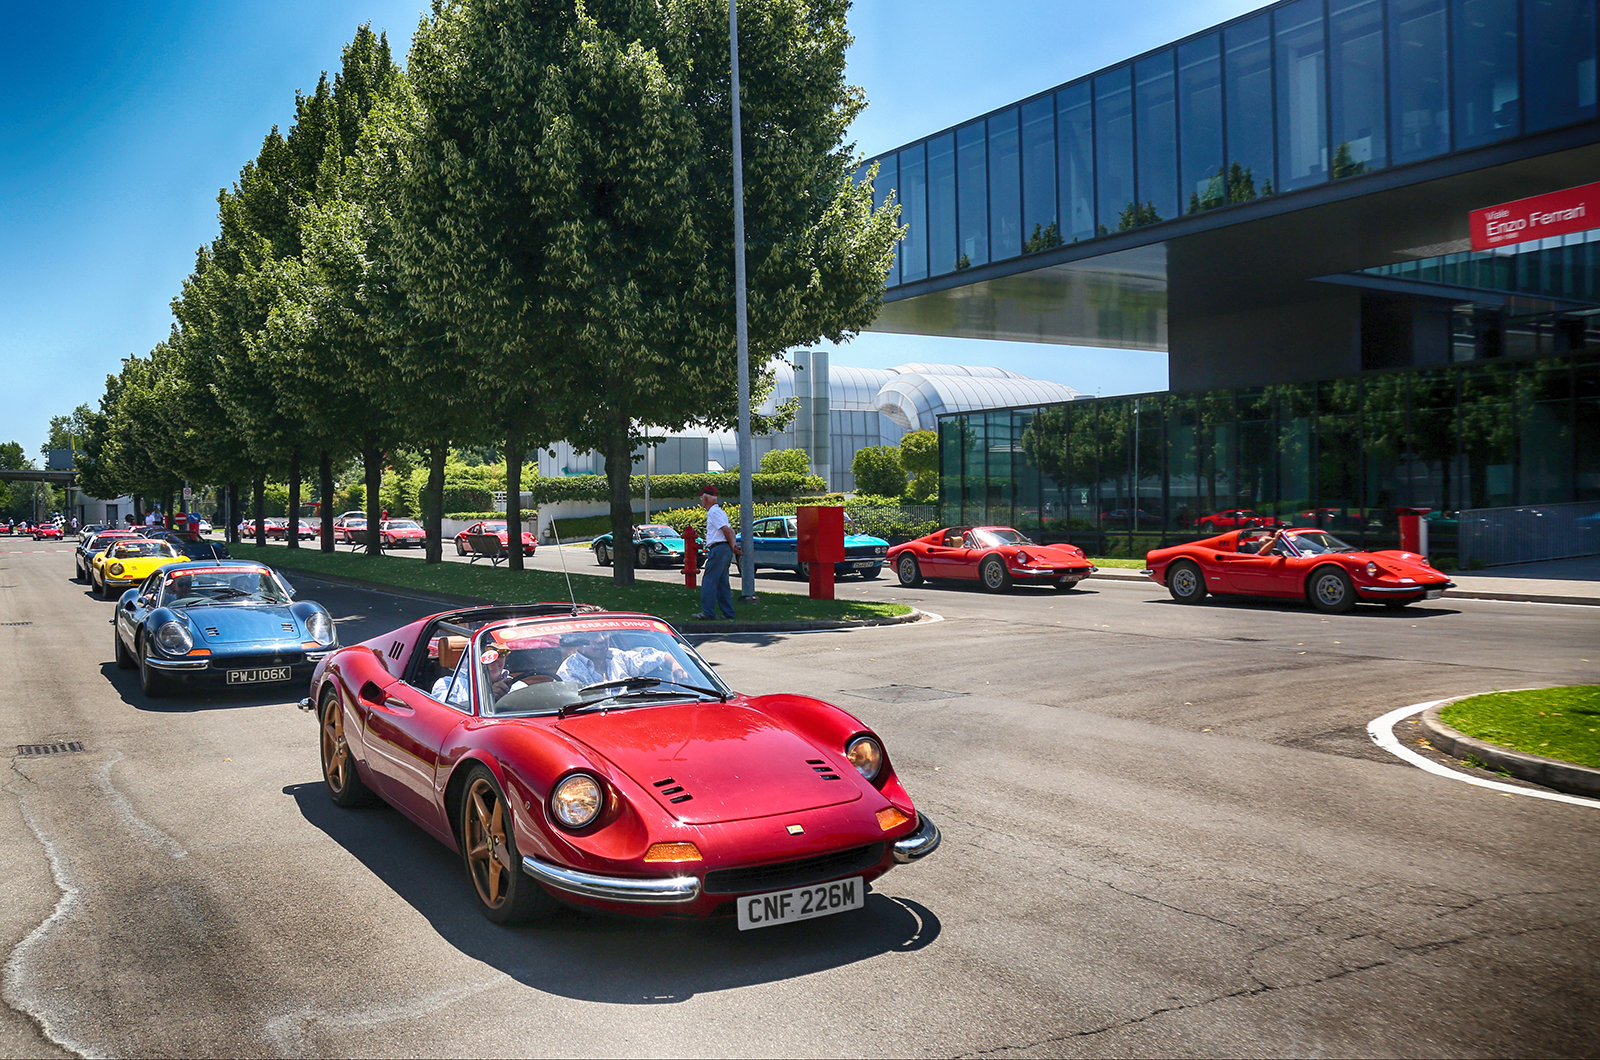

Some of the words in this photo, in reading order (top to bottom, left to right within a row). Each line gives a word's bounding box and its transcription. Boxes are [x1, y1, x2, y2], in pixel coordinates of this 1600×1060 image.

[1484, 209, 1510, 221] Viale
[1485, 218, 1527, 236] Enzo
[1529, 202, 1586, 227] Ferrari
[538, 623, 571, 633] YEARS
[574, 621, 620, 630] FERRARI
[623, 620, 651, 628] DINO
[748, 893, 793, 923] CNF
[800, 881, 855, 915] 226M
